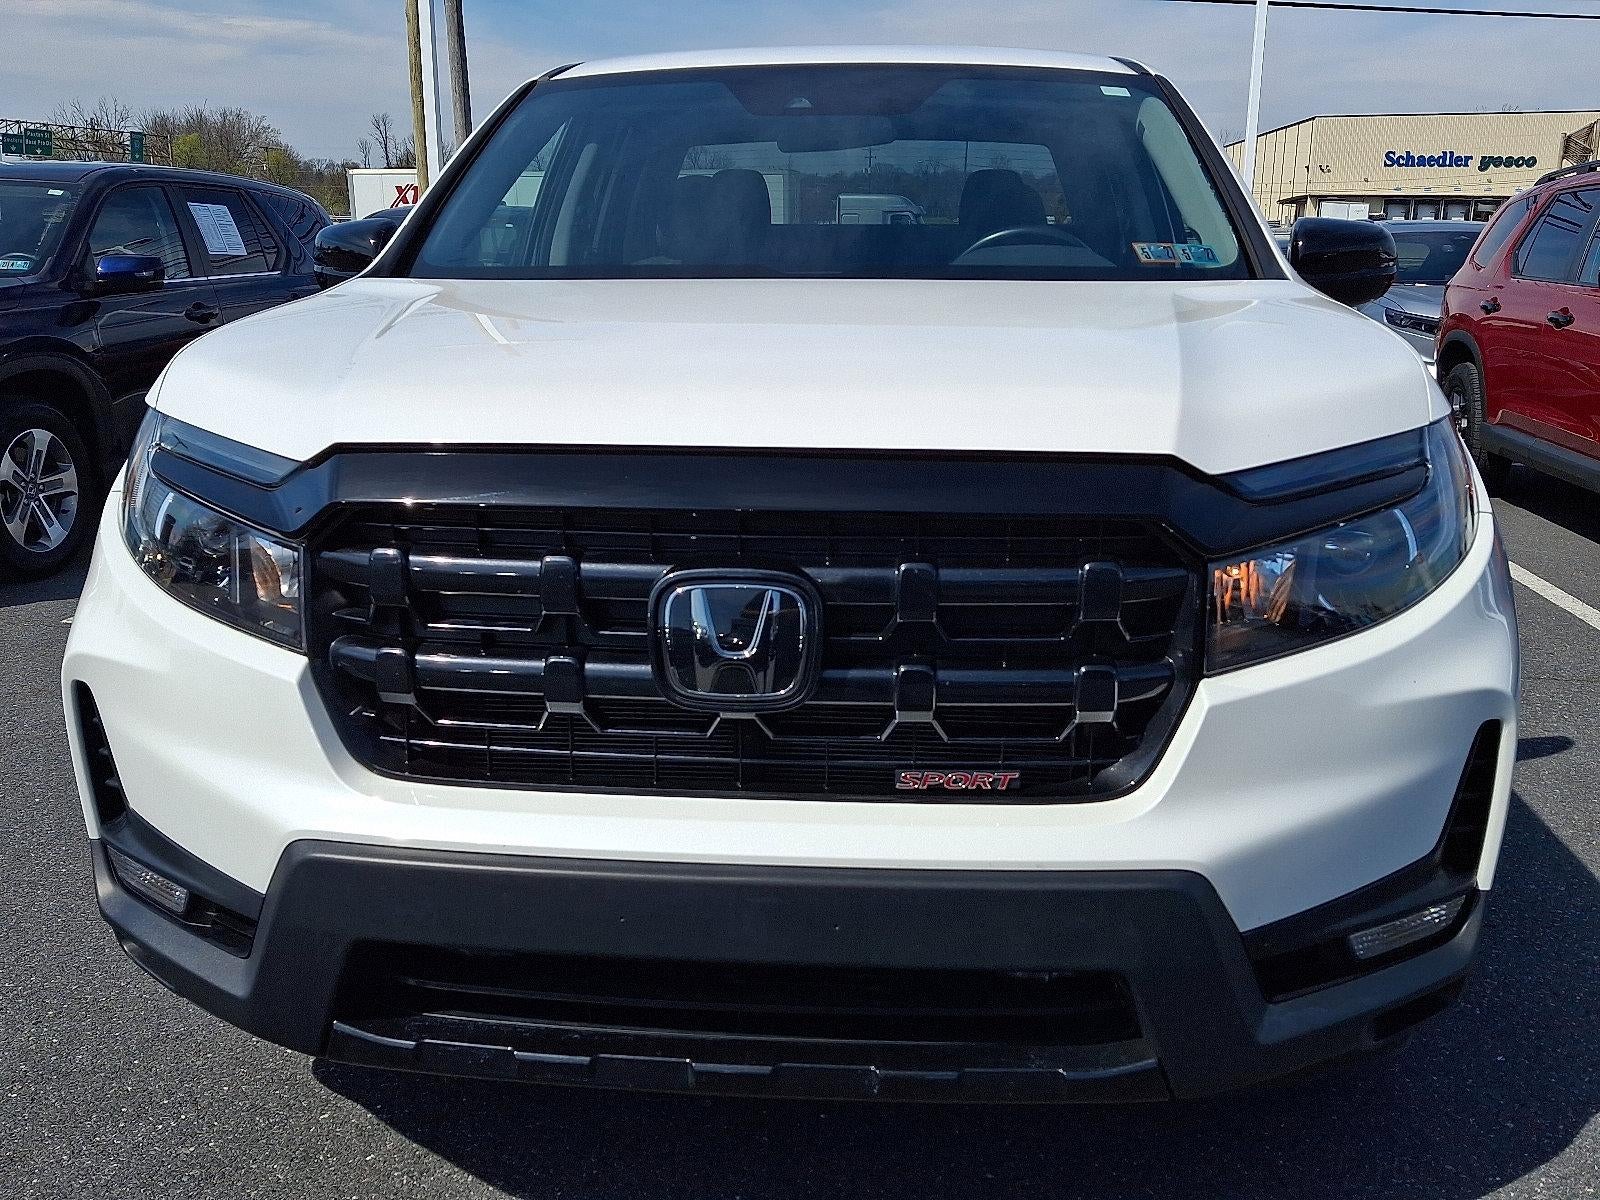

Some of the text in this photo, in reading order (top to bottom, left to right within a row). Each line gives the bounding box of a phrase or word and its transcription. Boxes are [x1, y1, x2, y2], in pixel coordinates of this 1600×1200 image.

[1383, 150, 1538, 172] Schaedler yesco
[895, 771, 1020, 790] SPORT
